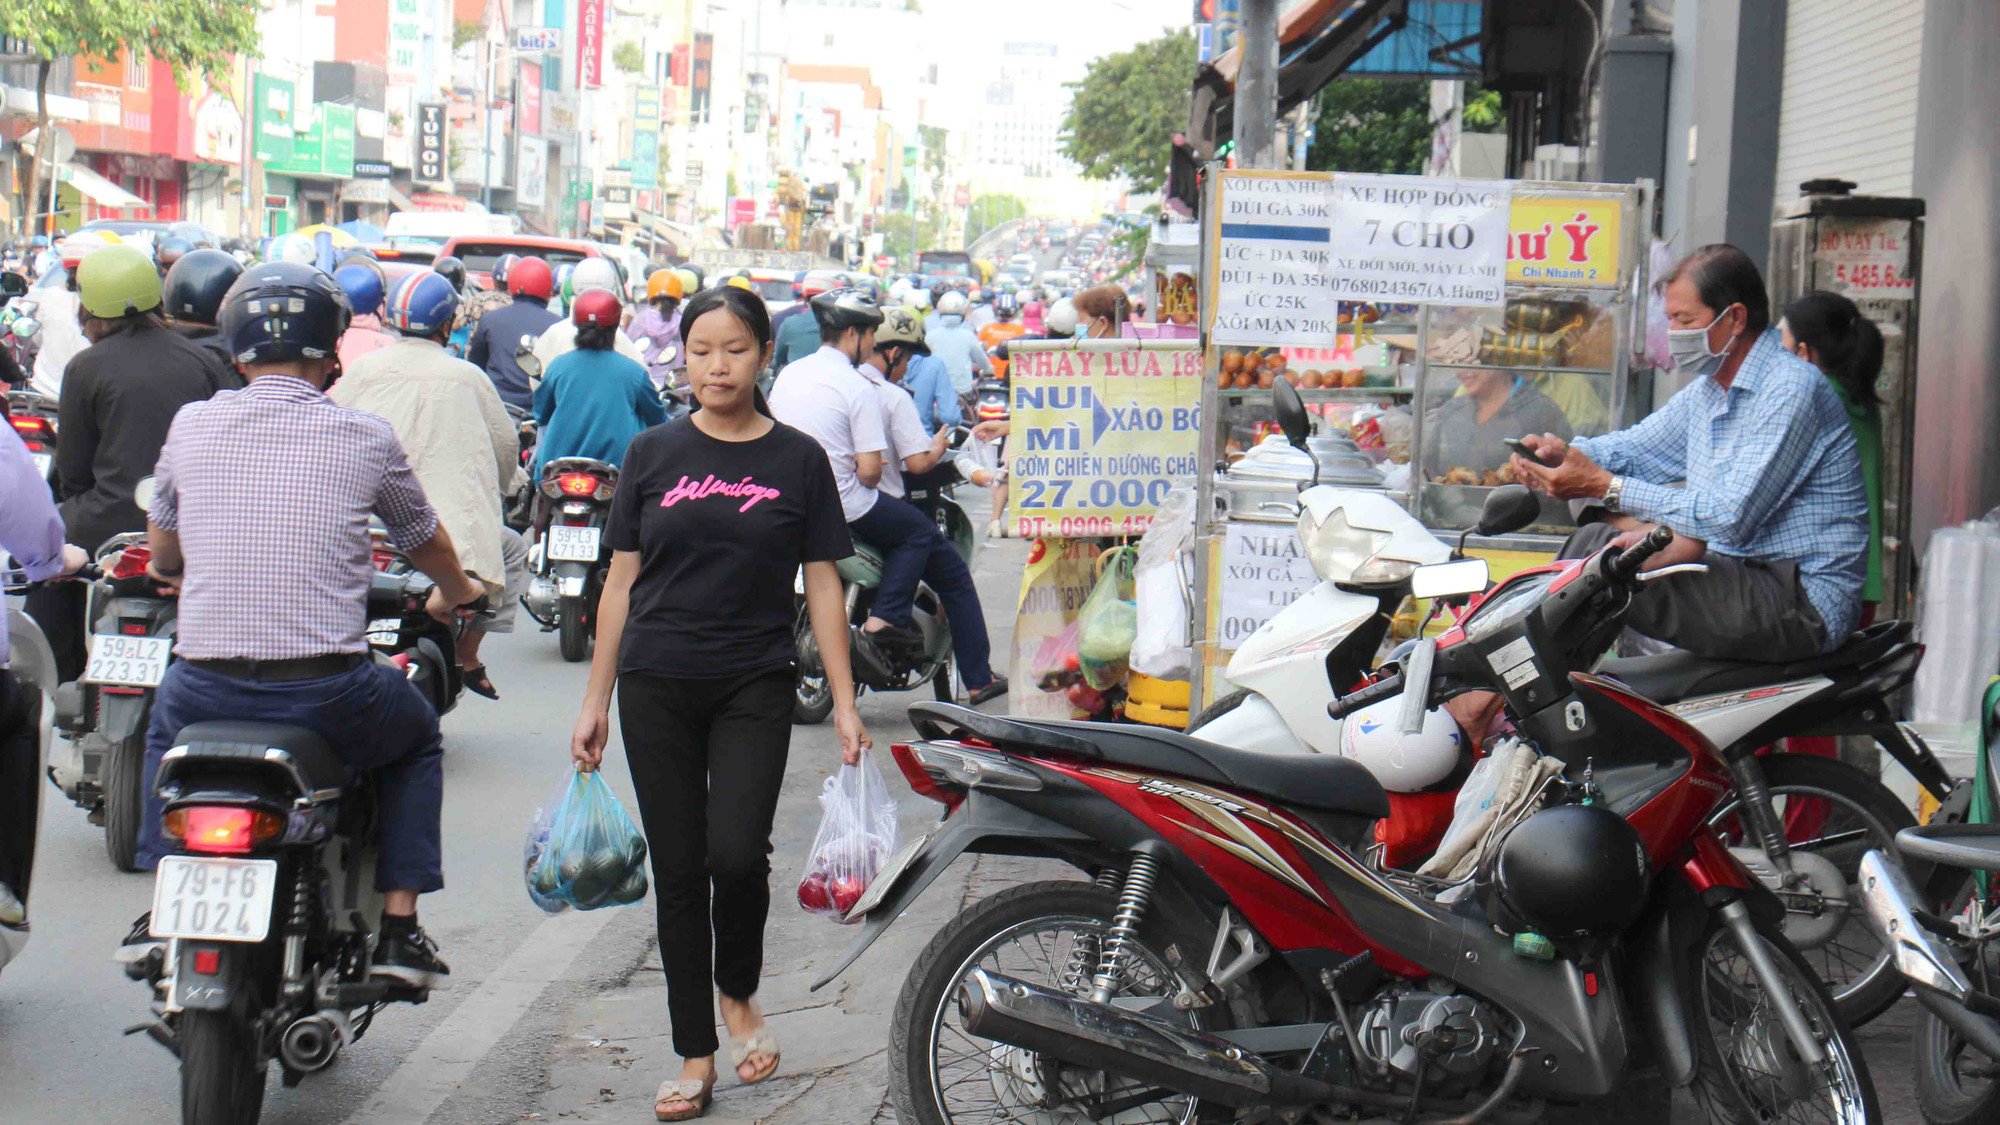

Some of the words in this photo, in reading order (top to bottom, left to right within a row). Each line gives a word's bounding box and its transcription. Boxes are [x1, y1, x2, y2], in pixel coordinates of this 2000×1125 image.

[1350, 186, 1376, 202] XE
[1298, 203, 1329, 218] 30K
[1364, 219, 1381, 245] 7
[1271, 249, 1293, 261] DA
[1300, 249, 1330, 264] 30K
[1272, 272, 1296, 286] DA
[1588, 268, 1597, 279] 2
[1275, 295, 1308, 310] 25K
[1301, 319, 1333, 334] 20K
[1015, 386, 1092, 410] NUI
[1110, 401, 1164, 431] XÀO
[1026, 421, 1081, 451] MÌ
[1015, 453, 1050, 477] CƠM
[1054, 452, 1102, 476] CHIÊN
[1060, 516, 1113, 538] 0906
[1239, 534, 1308, 563] NHẬ
[1227, 562, 1262, 581] XÔI
[89, 659, 160, 684] 223.31
[175, 863, 258, 898] 79-F6
[170, 898, 251, 935] 1024
